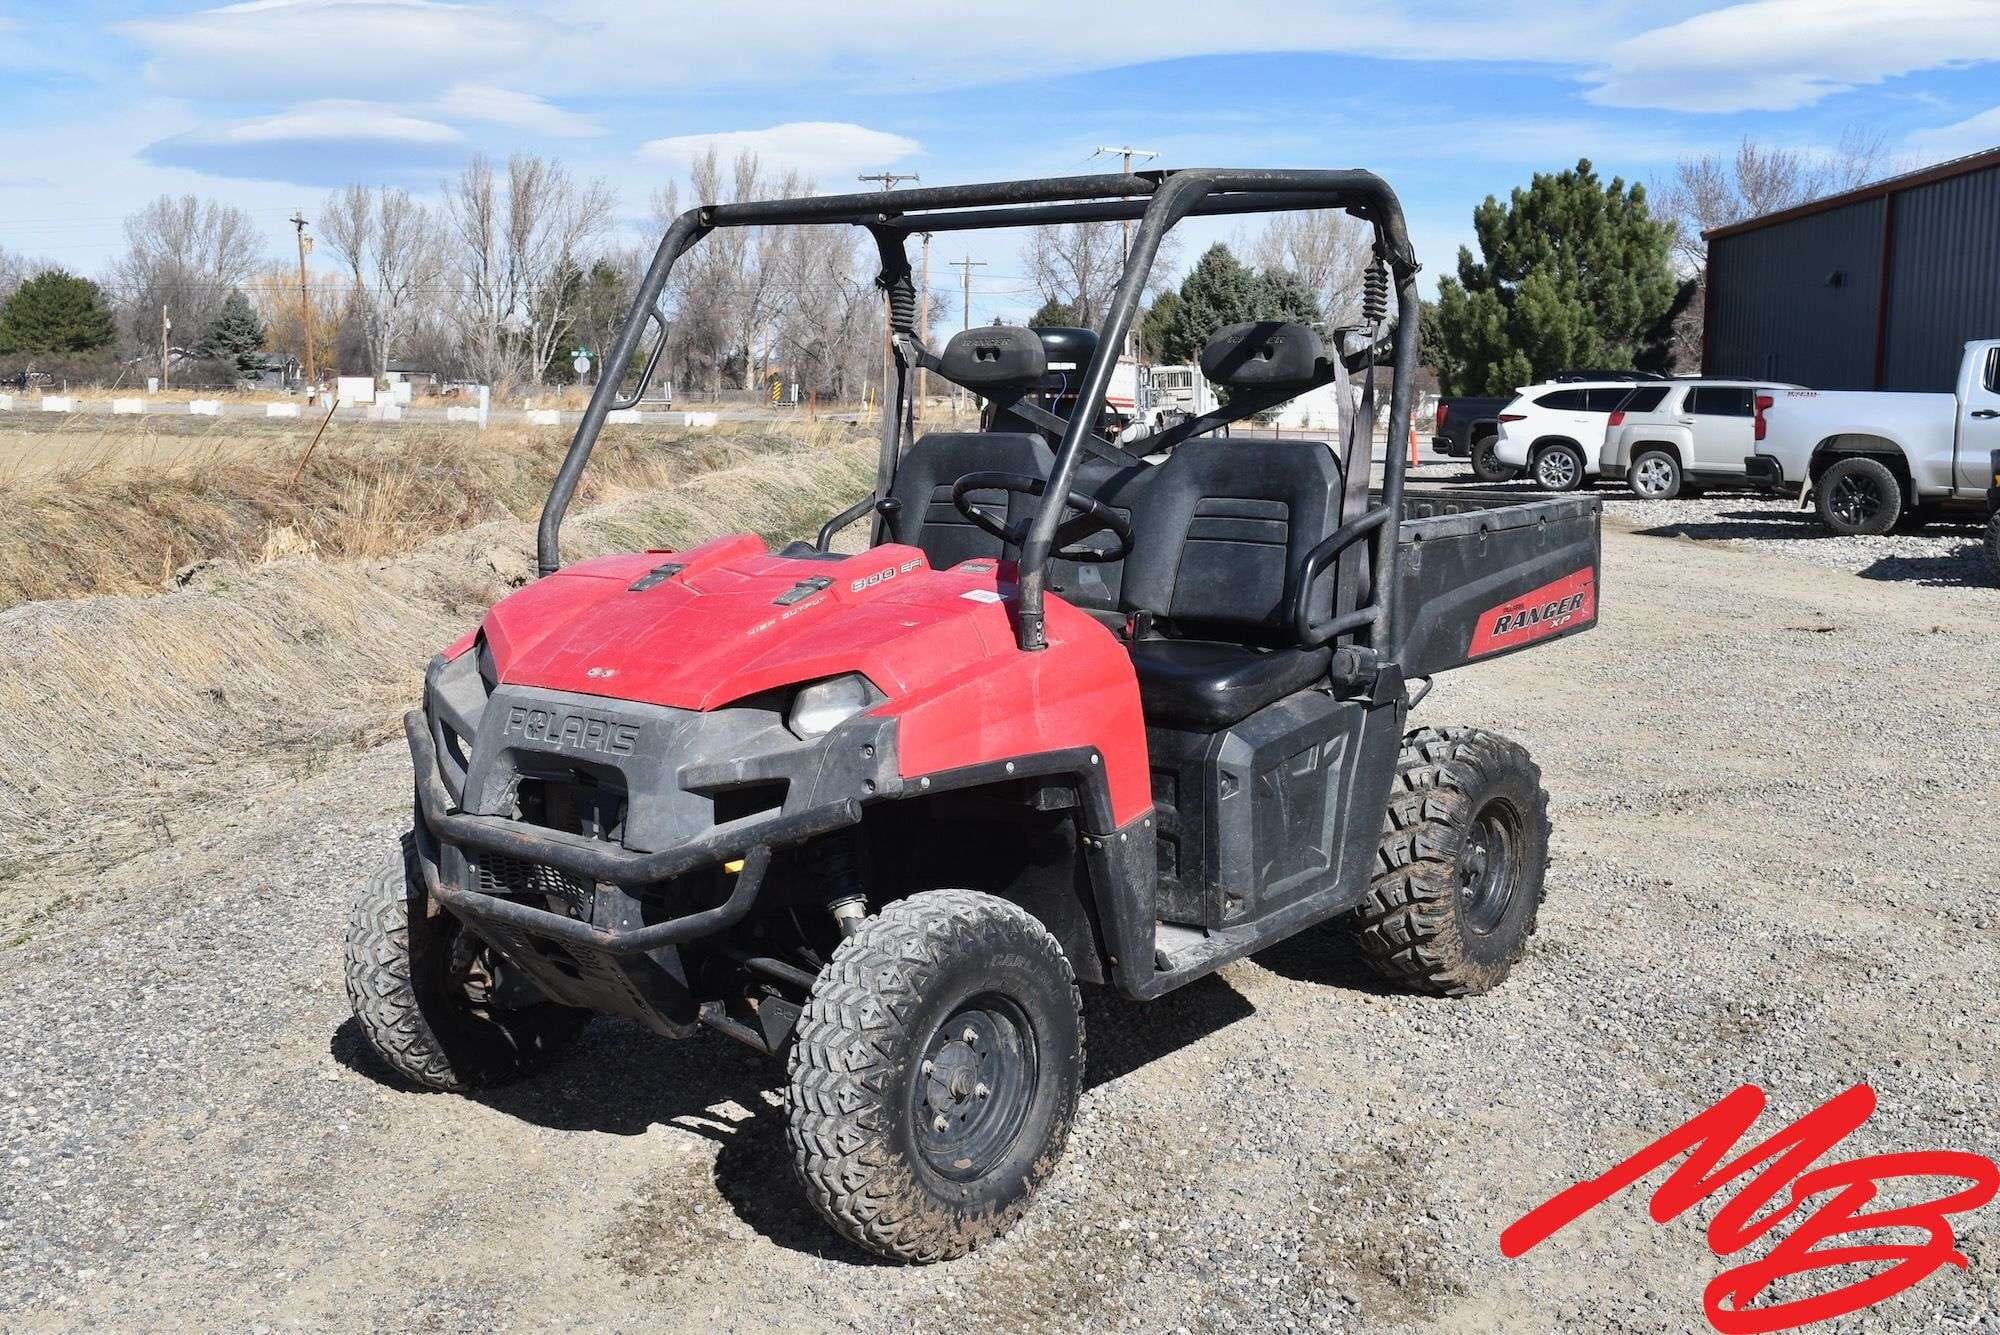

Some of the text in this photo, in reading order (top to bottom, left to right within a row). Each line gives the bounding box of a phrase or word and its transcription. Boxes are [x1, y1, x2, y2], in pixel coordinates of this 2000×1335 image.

[851, 557, 924, 592] 800 EFI
[1491, 591, 1584, 637] RANGER
[1549, 614, 1571, 628] XP
[503, 705, 641, 757] POLARIS
